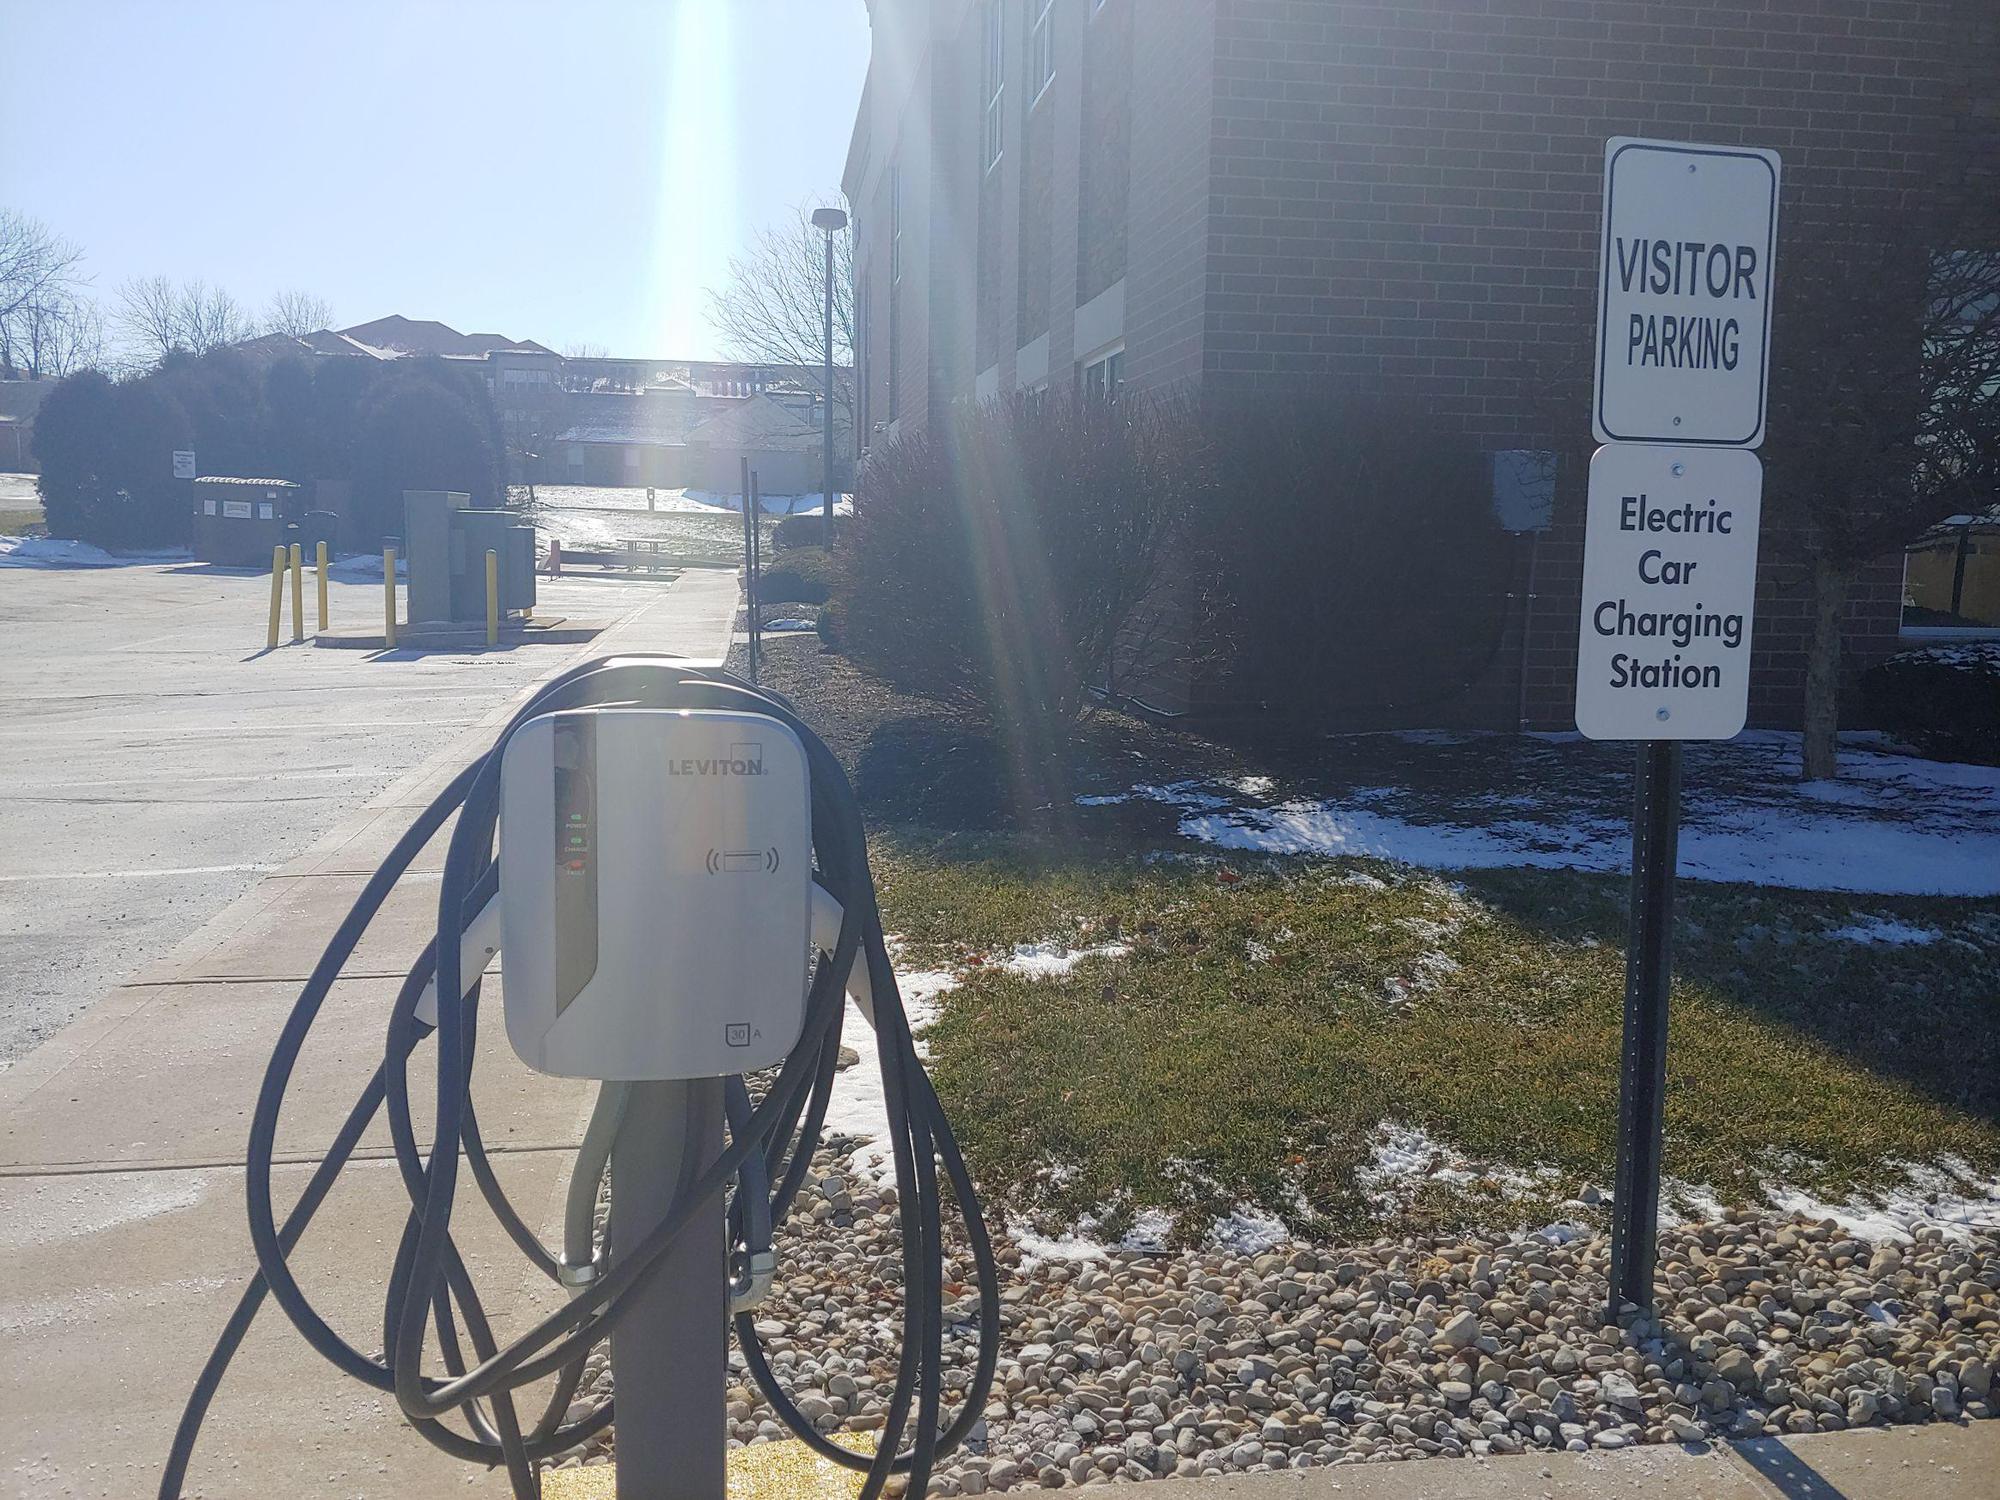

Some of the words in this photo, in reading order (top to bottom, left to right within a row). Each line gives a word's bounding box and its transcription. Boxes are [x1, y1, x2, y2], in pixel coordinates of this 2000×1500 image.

[1616, 237, 1757, 299] VISITOR
[1627, 313, 1740, 371] PARKING
[1620, 494, 1732, 534] Electric
[1638, 550, 1697, 584] Car
[1593, 600, 1743, 648] Charging
[1609, 654, 1720, 688] Station
[668, 759, 761, 776] LEVITON
[731, 1029, 745, 1040] 30
[753, 1029, 762, 1039] A
